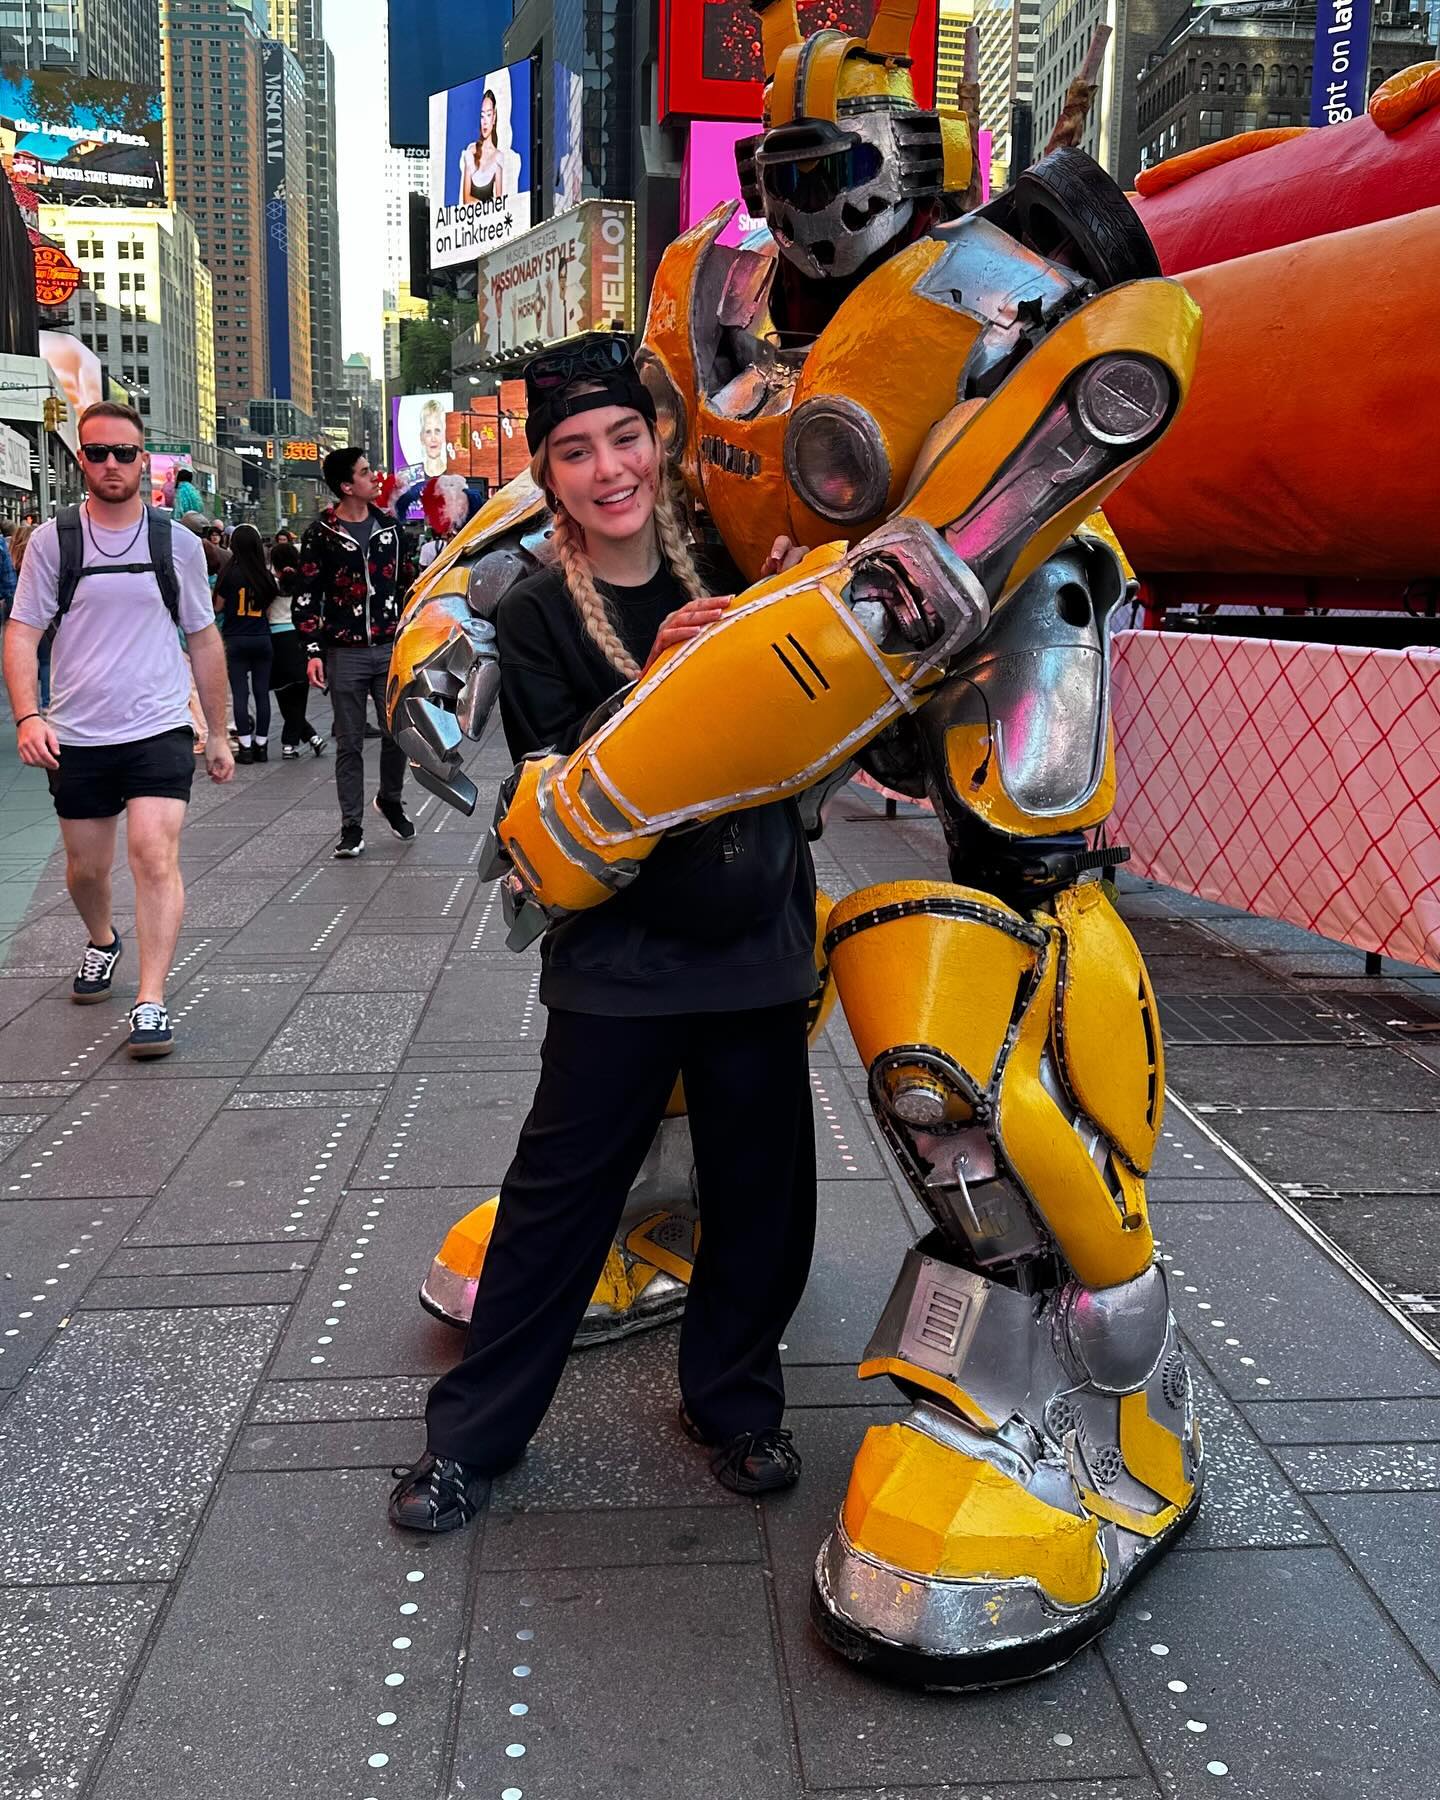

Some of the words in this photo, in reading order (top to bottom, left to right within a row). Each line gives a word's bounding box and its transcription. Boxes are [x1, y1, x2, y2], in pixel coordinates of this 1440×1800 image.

[1332, 40, 1350, 73] on
[14, 118, 40, 133] the
[42, 121, 106, 141] Longleaf
[108, 130, 150, 147] Pines.
[43, 165, 84, 181] VALDOSTA
[84, 169, 108, 185] STATE
[108, 172, 154, 190] UNIVERSITY
[436, 205, 452, 229] All
[454, 194, 509, 225] together
[436, 235, 452, 253] on
[505, 243, 530, 265] MUSICAL
[530, 230, 557, 253] THEATER
[491, 253, 544, 297] MISSIONARY
[545, 238, 576, 272] STYLE
[601, 208, 625, 332] HELLO!
[518, 296, 546, 320] MORMON
